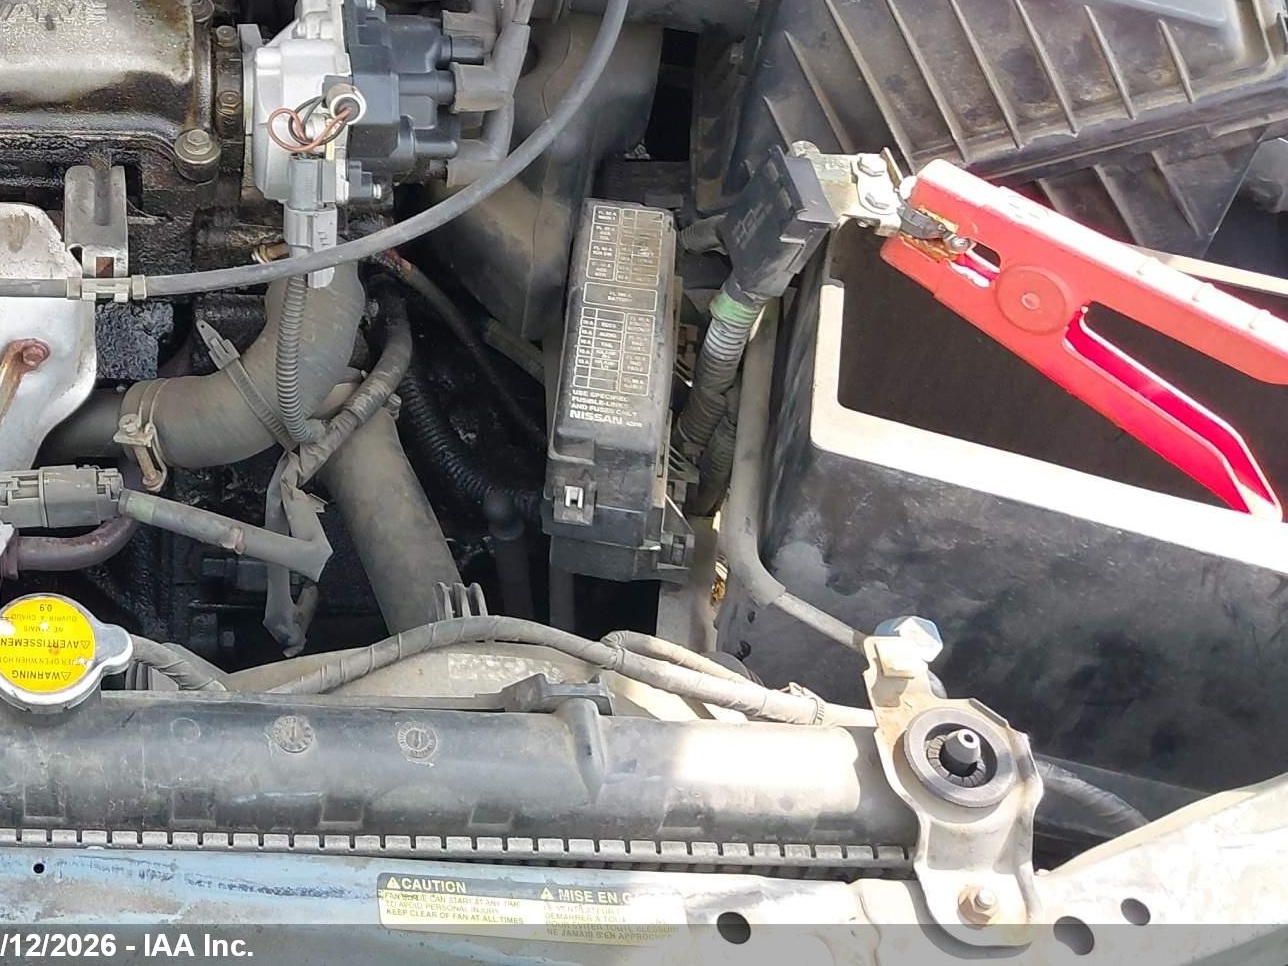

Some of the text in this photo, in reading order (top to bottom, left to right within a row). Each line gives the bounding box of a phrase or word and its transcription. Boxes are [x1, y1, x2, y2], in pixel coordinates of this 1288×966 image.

[570, 410, 623, 424] NISSAN
[11, 670, 60, 681] WARNING
[402, 878, 466, 894] CAUTION
[558, 889, 594, 902] MISE
[598, 891, 618, 904] EN
[410, 910, 437, 918] CLEAR
[452, 913, 469, 921] FAN
[483, 915, 497, 923] ALL
[499, 916, 524, 924] TIMES
